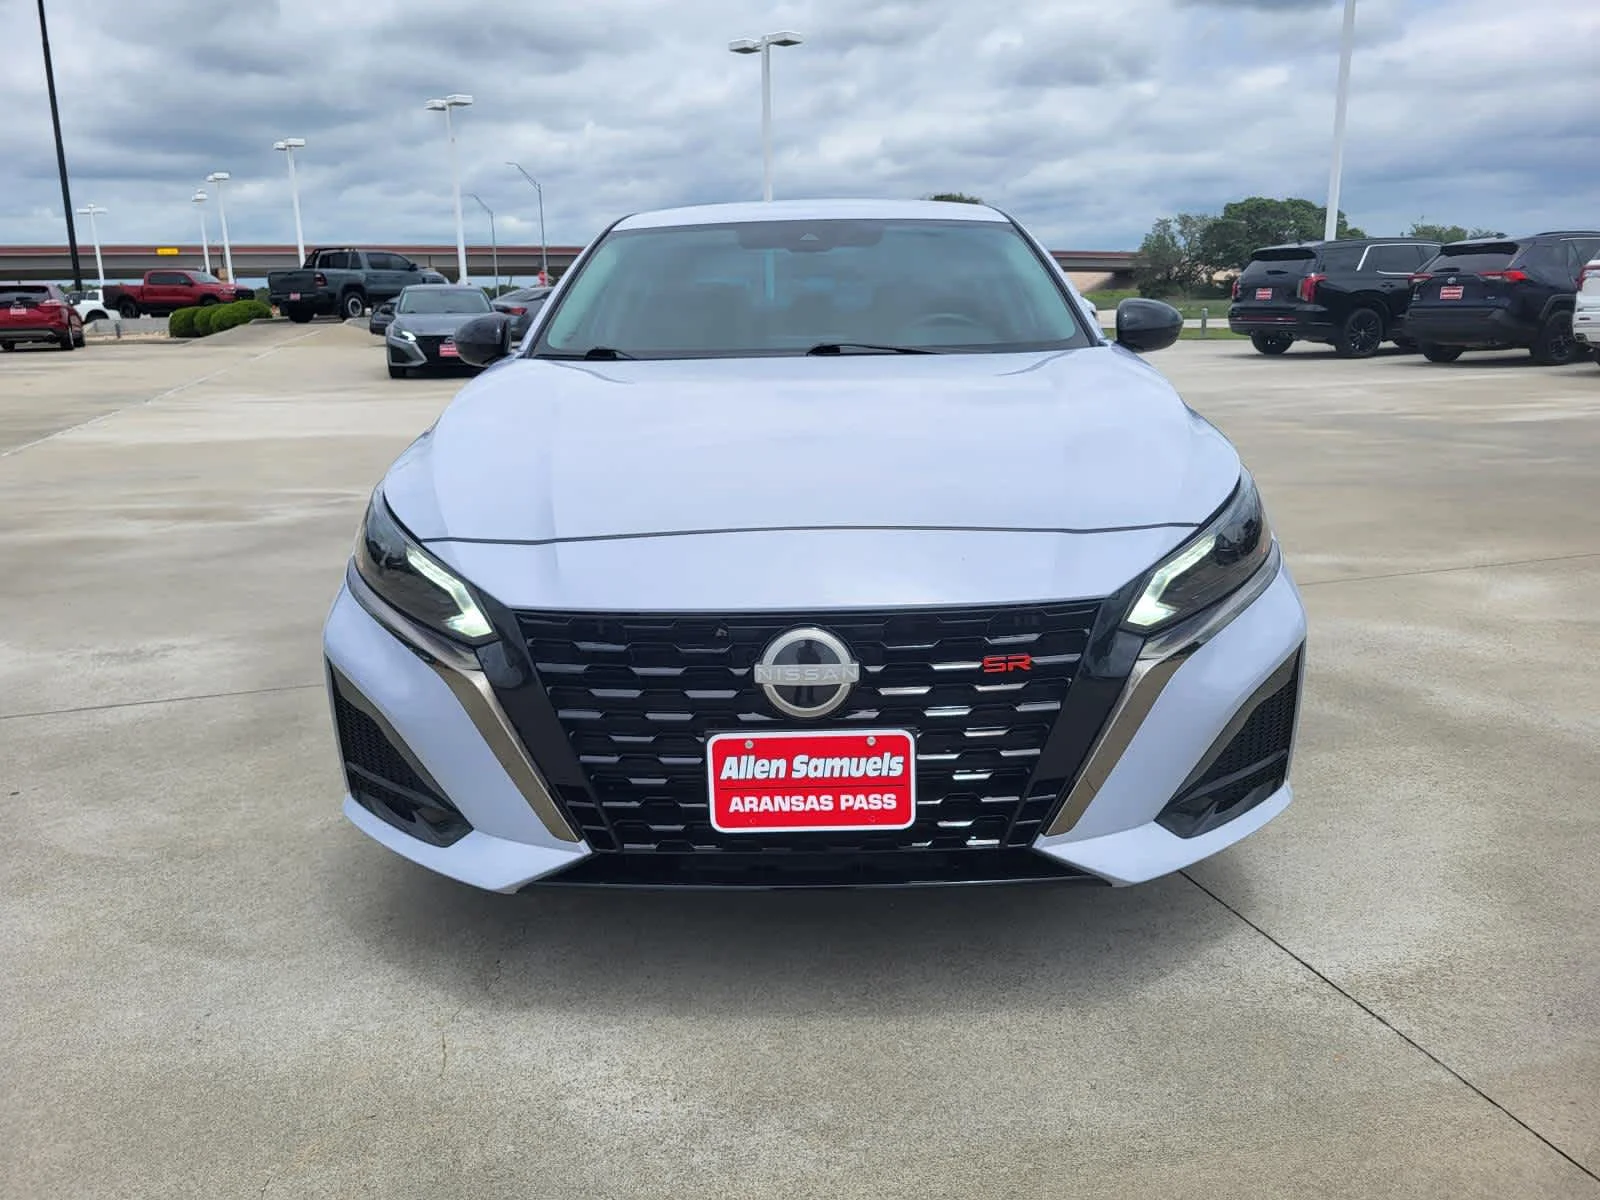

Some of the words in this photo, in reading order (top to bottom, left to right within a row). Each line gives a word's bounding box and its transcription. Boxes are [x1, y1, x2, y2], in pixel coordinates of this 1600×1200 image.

[983, 653, 1032, 673] SR
[757, 667, 857, 682] NISSAN
[720, 755, 787, 780] Allen
[791, 752, 904, 778] Samuels
[728, 795, 834, 813] ARANSAS
[840, 793, 897, 811] PASS
